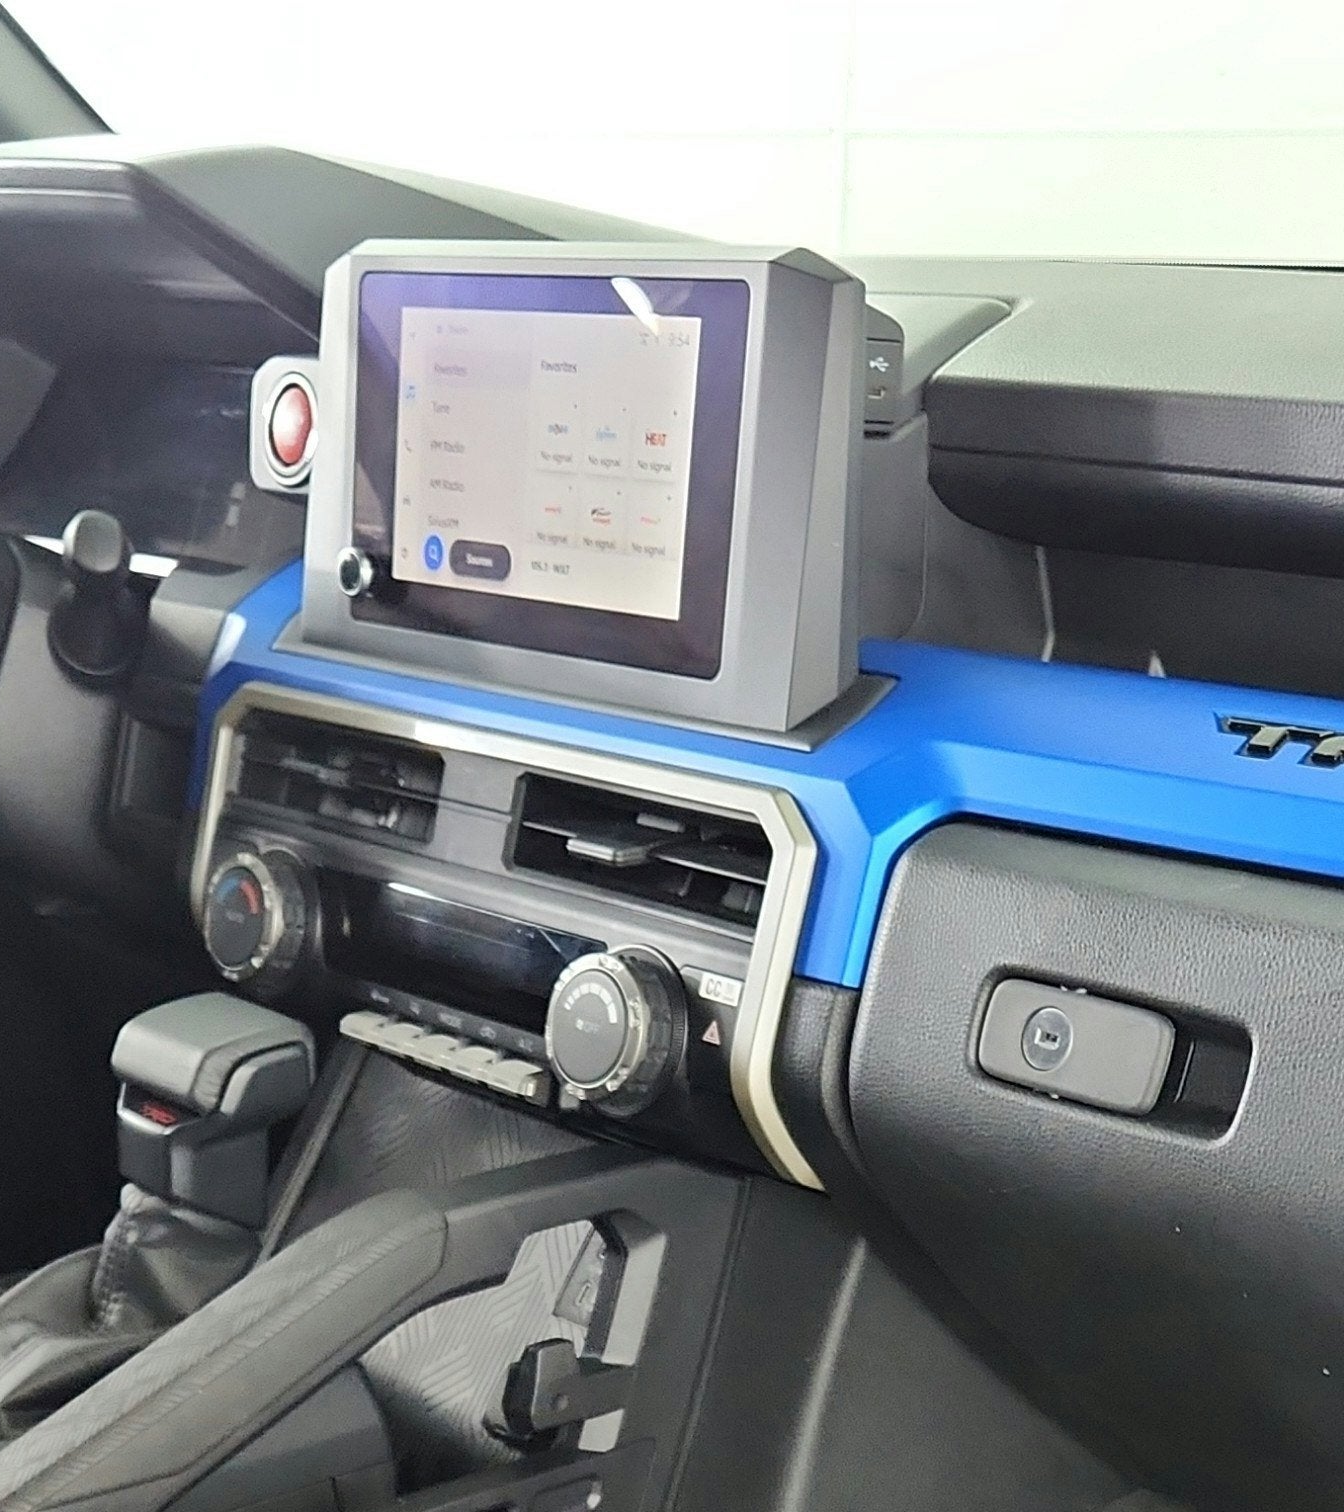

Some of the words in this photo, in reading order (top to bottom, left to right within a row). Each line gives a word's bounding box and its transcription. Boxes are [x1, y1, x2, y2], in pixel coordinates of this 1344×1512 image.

[540, 359, 578, 373] Favorites
[552, 453, 573, 466] signal
[588, 455, 599, 466] No
[600, 457, 620, 468] signal
[637, 459, 648, 470] No
[650, 460, 672, 473] signal
[583, 537, 593, 548] No
[595, 539, 616, 551] signal
[631, 541, 643, 553] No
[644, 545, 666, 558] signal
